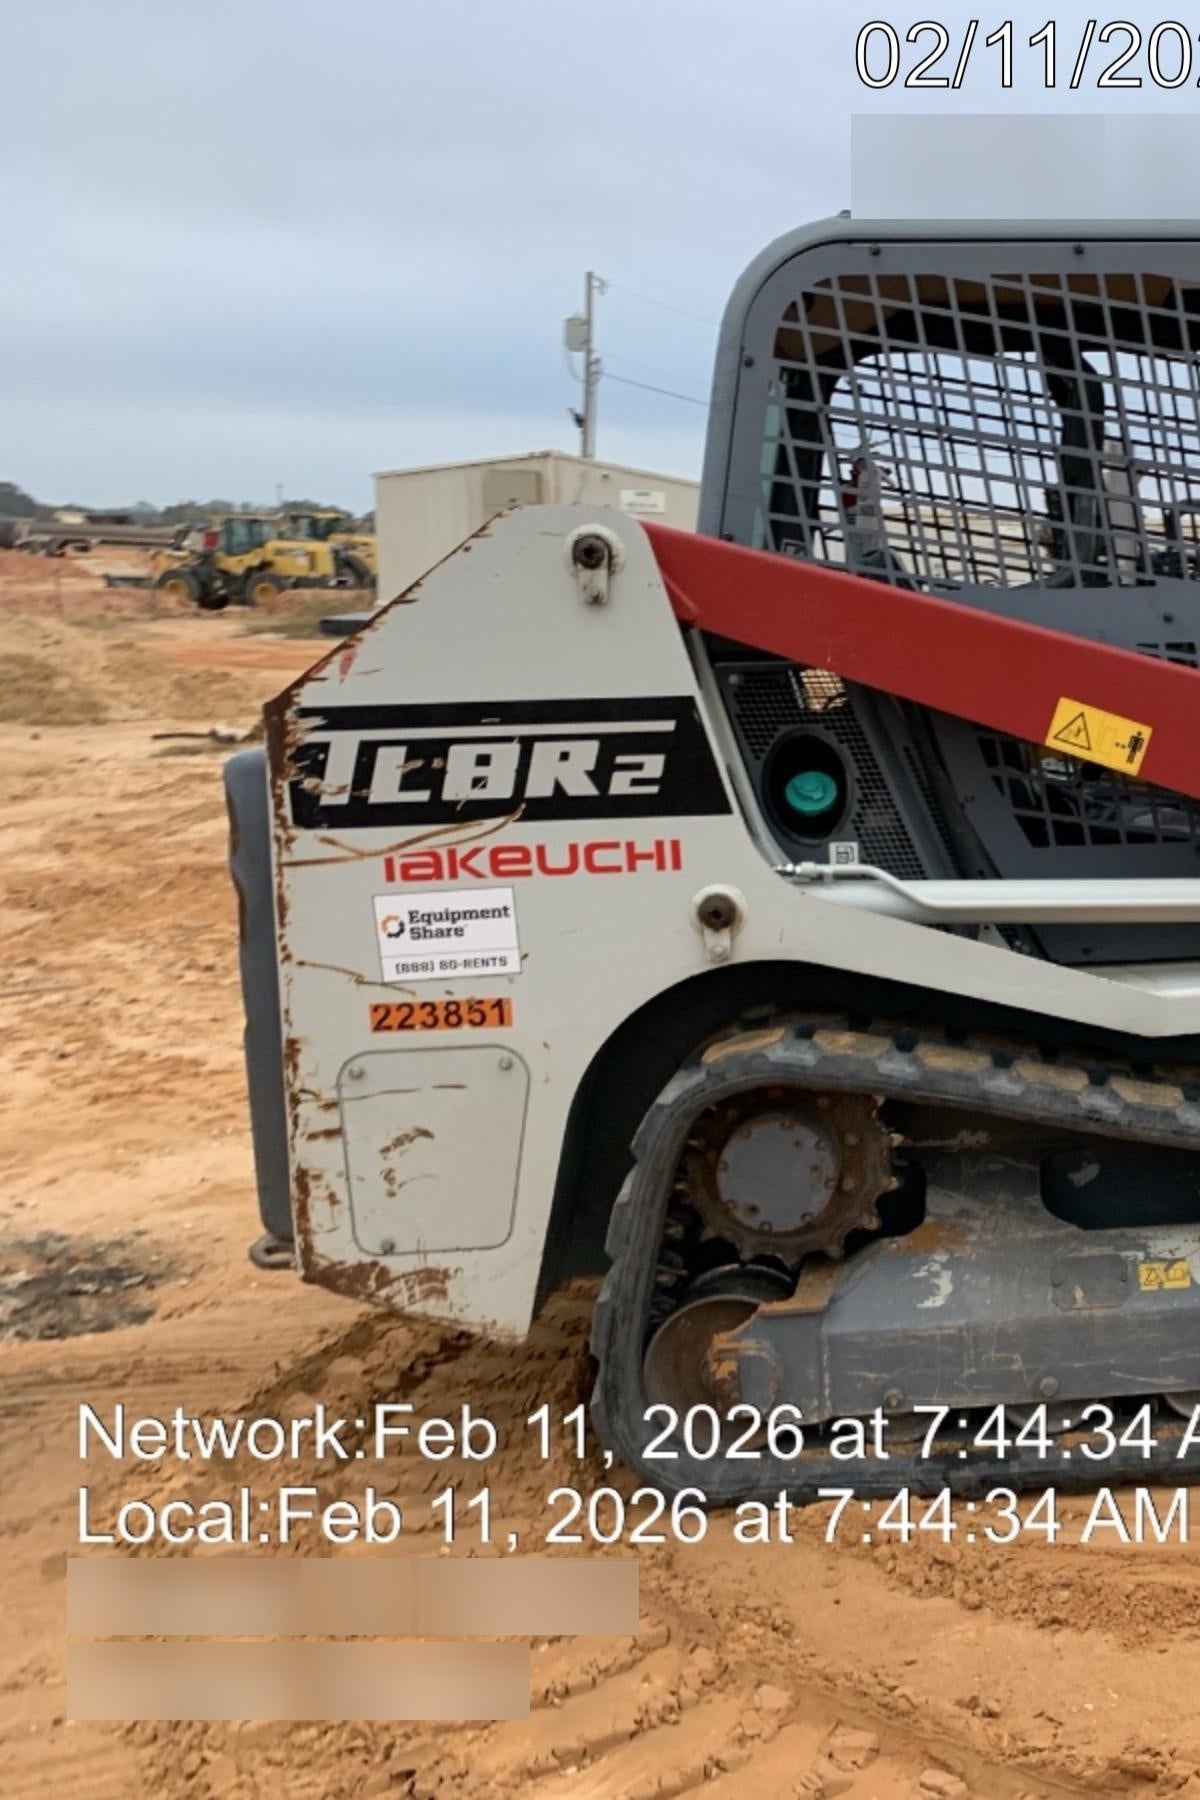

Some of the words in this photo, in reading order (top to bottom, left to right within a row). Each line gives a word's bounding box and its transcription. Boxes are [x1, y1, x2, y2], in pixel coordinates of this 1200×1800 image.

[408, 905, 510, 926] Equipment
[410, 926, 465, 940] Share
[372, 998, 505, 1032] 223851
